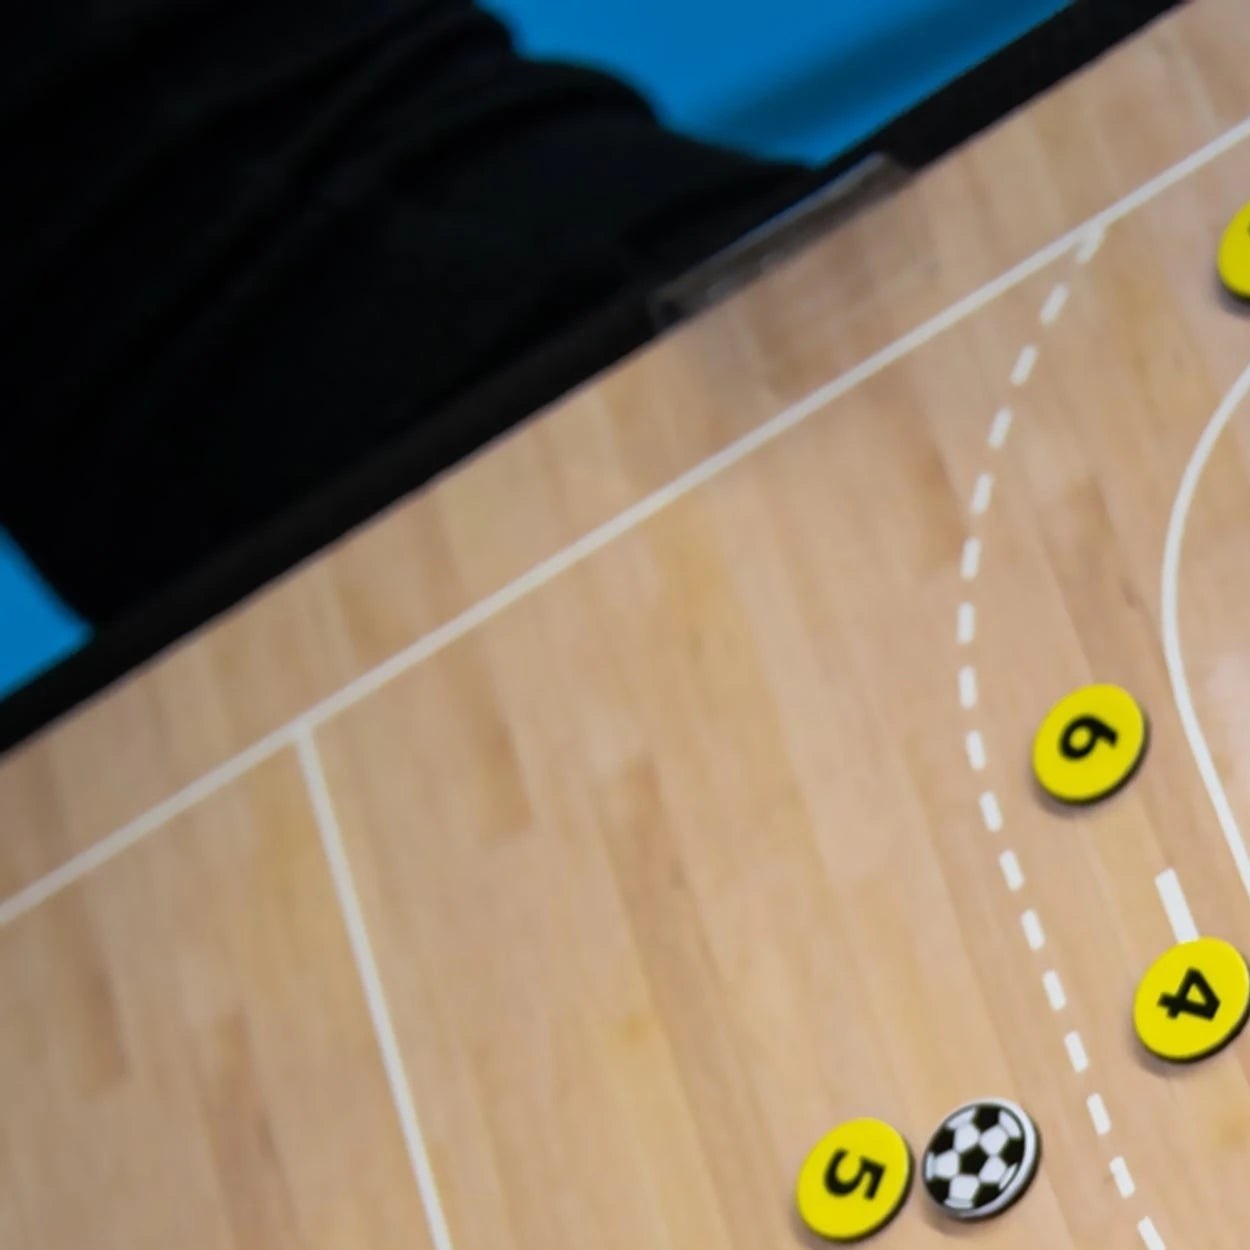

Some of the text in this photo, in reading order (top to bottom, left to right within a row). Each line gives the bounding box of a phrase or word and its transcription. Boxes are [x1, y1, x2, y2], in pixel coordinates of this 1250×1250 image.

[1058, 713, 1120, 762] 6
[1157, 967, 1222, 1022] 4
[823, 1148, 887, 1201] 5
